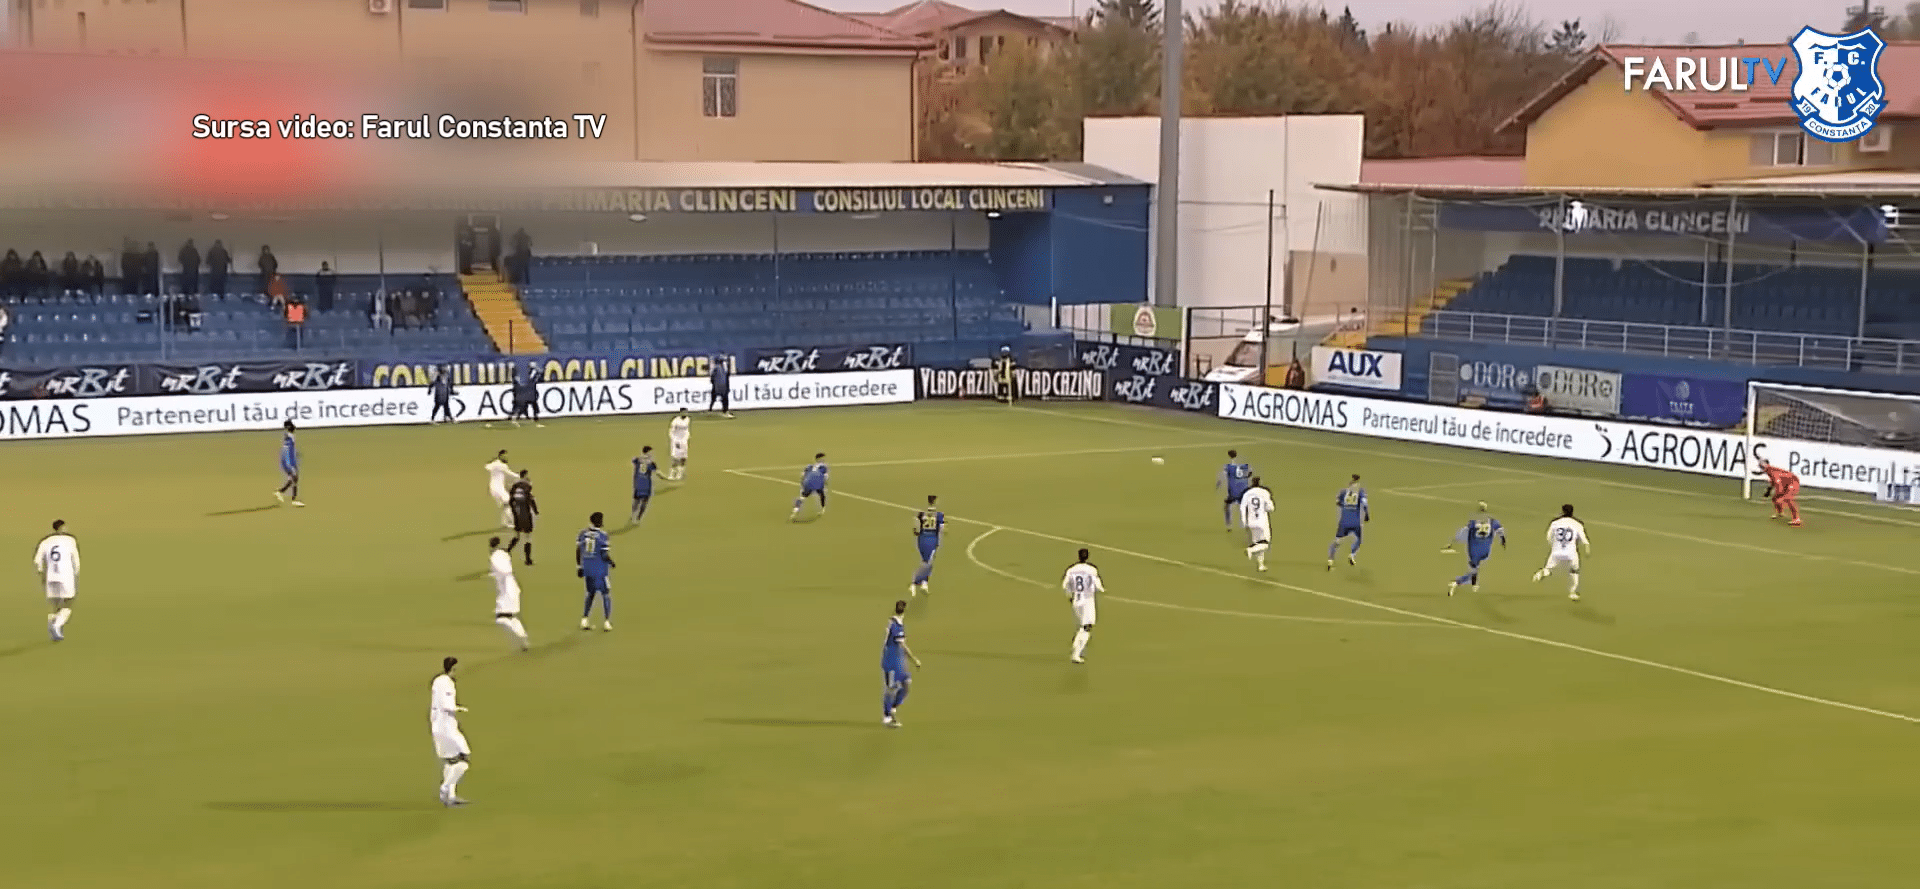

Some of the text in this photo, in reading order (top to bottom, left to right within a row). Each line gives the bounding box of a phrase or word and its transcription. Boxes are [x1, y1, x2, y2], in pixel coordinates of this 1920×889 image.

[679, 189, 797, 212] CLINCENI
[812, 188, 1045, 212] CONSILIUL LOCAL CLINCENI
[1328, 351, 1383, 378] AUX
[920, 368, 957, 398] VLAD
[1014, 368, 1102, 399] VLAD CAZINO
[478, 384, 632, 416] AGOMAS
[788, 381, 812, 400] de
[118, 403, 236, 427] Partenerul
[285, 401, 313, 420] de
[1243, 390, 1348, 428] AGROMAS
[1363, 407, 1438, 435] Partenerul
[1443, 417, 1467, 438] tău
[1471, 420, 1492, 441] de
[1621, 429, 1769, 475] AGROMAS
[1251, 497, 1261, 511] 9
[1556, 527, 1573, 543] 30
[50, 545, 61, 562] 6
[1075, 575, 1084, 592] 8
